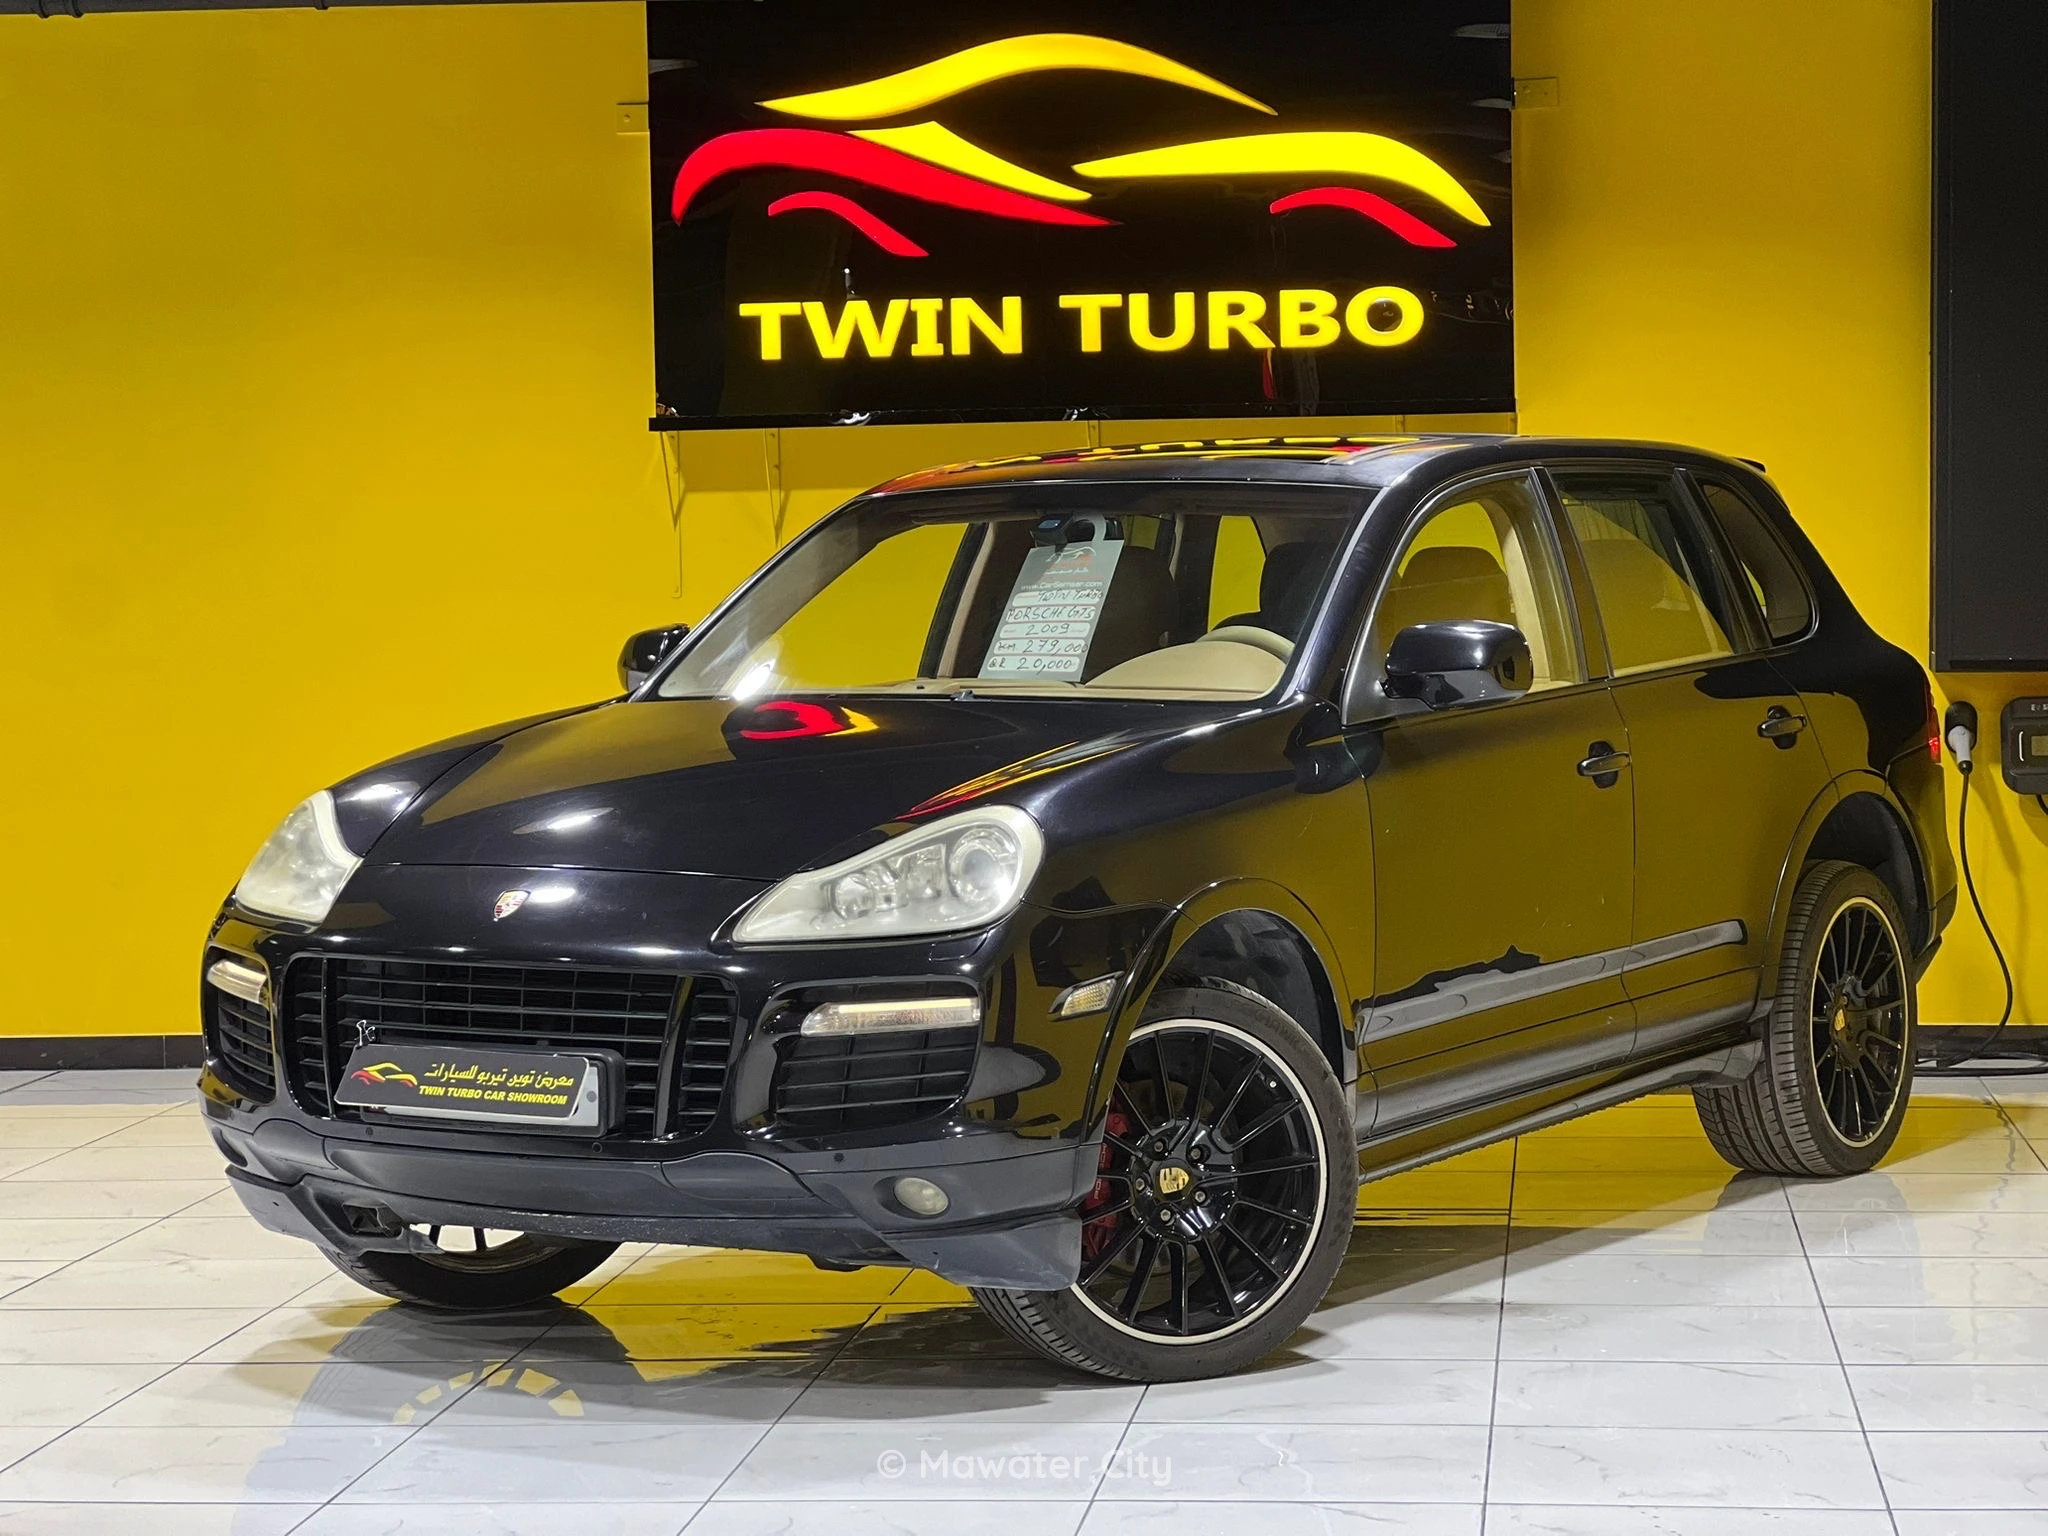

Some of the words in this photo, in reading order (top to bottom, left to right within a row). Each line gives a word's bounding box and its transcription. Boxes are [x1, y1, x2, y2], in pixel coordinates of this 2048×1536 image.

[739, 297, 1023, 361] TWIN
[1059, 286, 1425, 354] TURBO
[1007, 606, 1064, 621] PORSCHE
[1025, 624, 1070, 636] 2009
[1022, 639, 1089, 656] 279,000
[1016, 657, 1072, 675] 20,000
[424, 1063, 479, 1084] للسيارات
[477, 1068, 508, 1086] تيربو
[506, 1070, 536, 1088] توين
[534, 1071, 574, 1090] معرض
[419, 1085, 445, 1096] TWIN
[447, 1086, 482, 1099] TURBO
[484, 1091, 505, 1101] CAR
[507, 1092, 567, 1105] SHOWROOM
